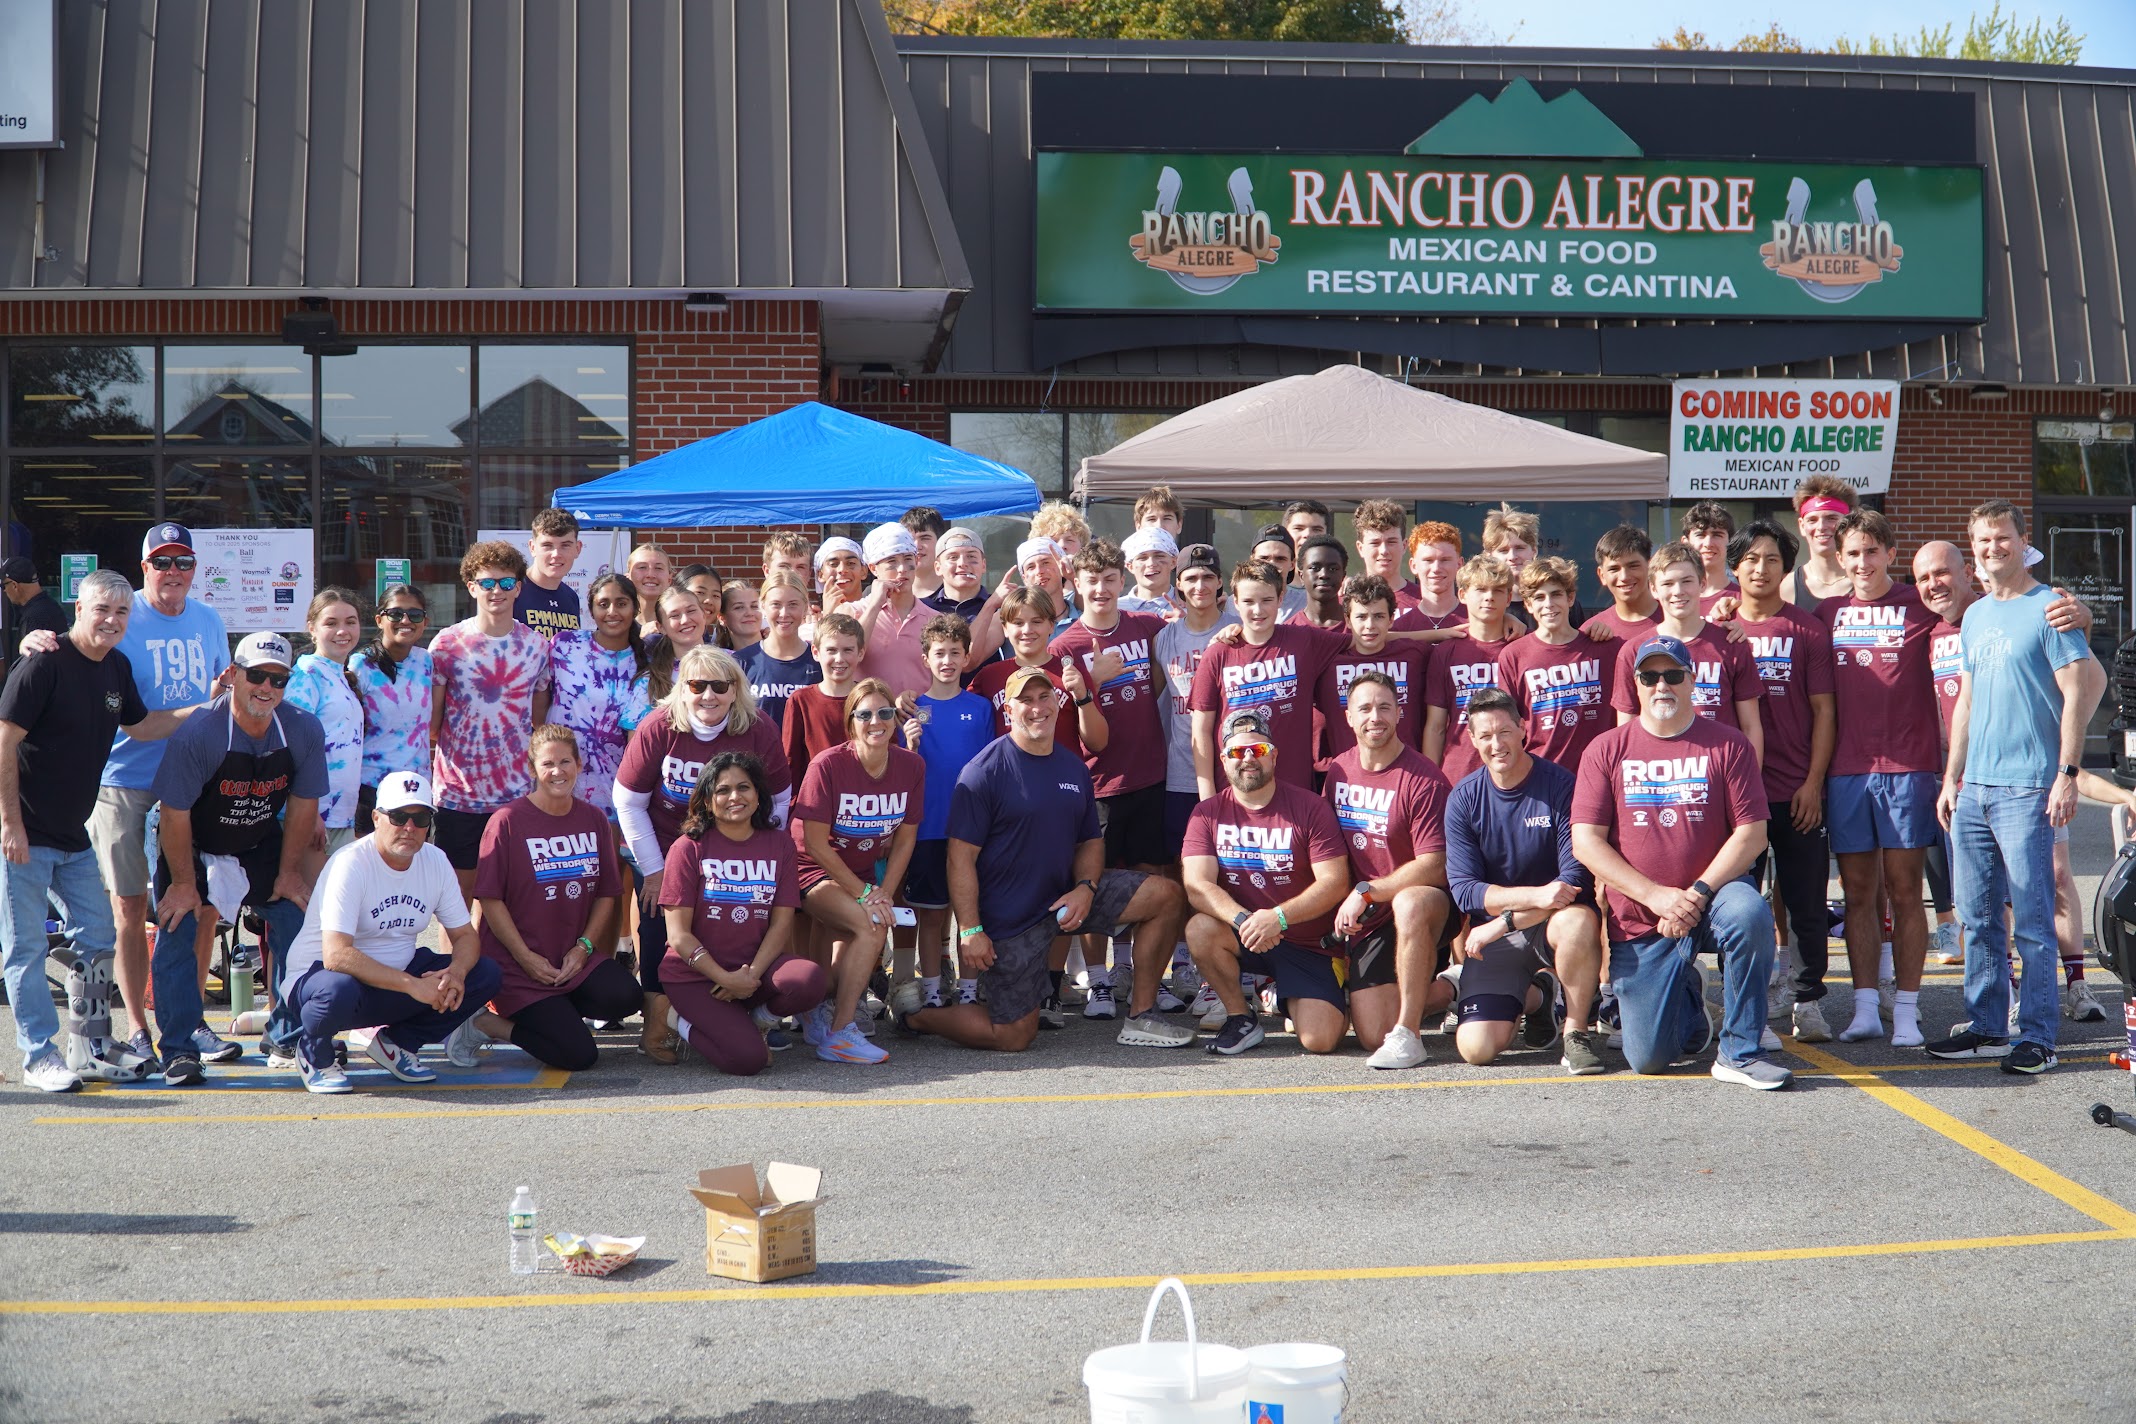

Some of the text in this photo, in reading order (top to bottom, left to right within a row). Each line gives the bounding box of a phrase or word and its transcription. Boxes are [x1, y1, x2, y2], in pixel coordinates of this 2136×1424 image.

[1289, 168, 1756, 232] RANCHO ALEGRE
[1142, 210, 1272, 258] RANCHO
[1772, 220, 1894, 266] RANCHO
[1178, 250, 1234, 266] ALEGRE
[1389, 238, 1658, 265] MEXICAN FOOD
[1806, 259, 1860, 274] ALEGRE
[1308, 269, 1738, 298] RESTAURANT & CANTINA
[1680, 390, 1892, 420] COMING SOON
[1683, 424, 1885, 453] RANCHO ALEGRE
[1725, 459, 1840, 472] MEXICAN FOOD
[1690, 478, 1790, 490] RESTAURANT
[2082, 575, 2094, 584] &
[526, 610, 580, 629] EMMANUEL
[1834, 606, 1907, 626] ROW
[1832, 629, 1905, 638] WESTBOROUGH
[256, 642, 284, 654] USA
[1748, 636, 1793, 658] OW
[146, 638, 207, 694] T9B
[1223, 654, 1296, 688] ROW
[1450, 662, 1498, 686] RO
[1525, 659, 1600, 691] ROW
[1226, 679, 1297, 698] WESTBOROUGH
[1532, 685, 1602, 703] WESTBOROUGH
[662, 755, 705, 783] RO
[1622, 756, 1708, 782] ROW
[1335, 781, 1396, 812] ROW
[1624, 783, 1708, 794] WESTBOROUGH
[234, 798, 250, 806] THE
[838, 792, 908, 816] ROW
[220, 816, 239, 825] THE
[836, 817, 904, 828] WESTBOROUGH
[1524, 816, 1550, 827] WASA
[526, 832, 598, 860] ROW
[1216, 824, 1292, 849] ROW
[534, 858, 599, 872] WESTBOROUGH
[1217, 850, 1294, 862] WESTBOROUGH
[702, 858, 776, 881] ROW
[705, 883, 776, 893] WESTBOROUGH
[370, 894, 426, 919] BUSHWOOD
[380, 918, 415, 930] CADDIE
